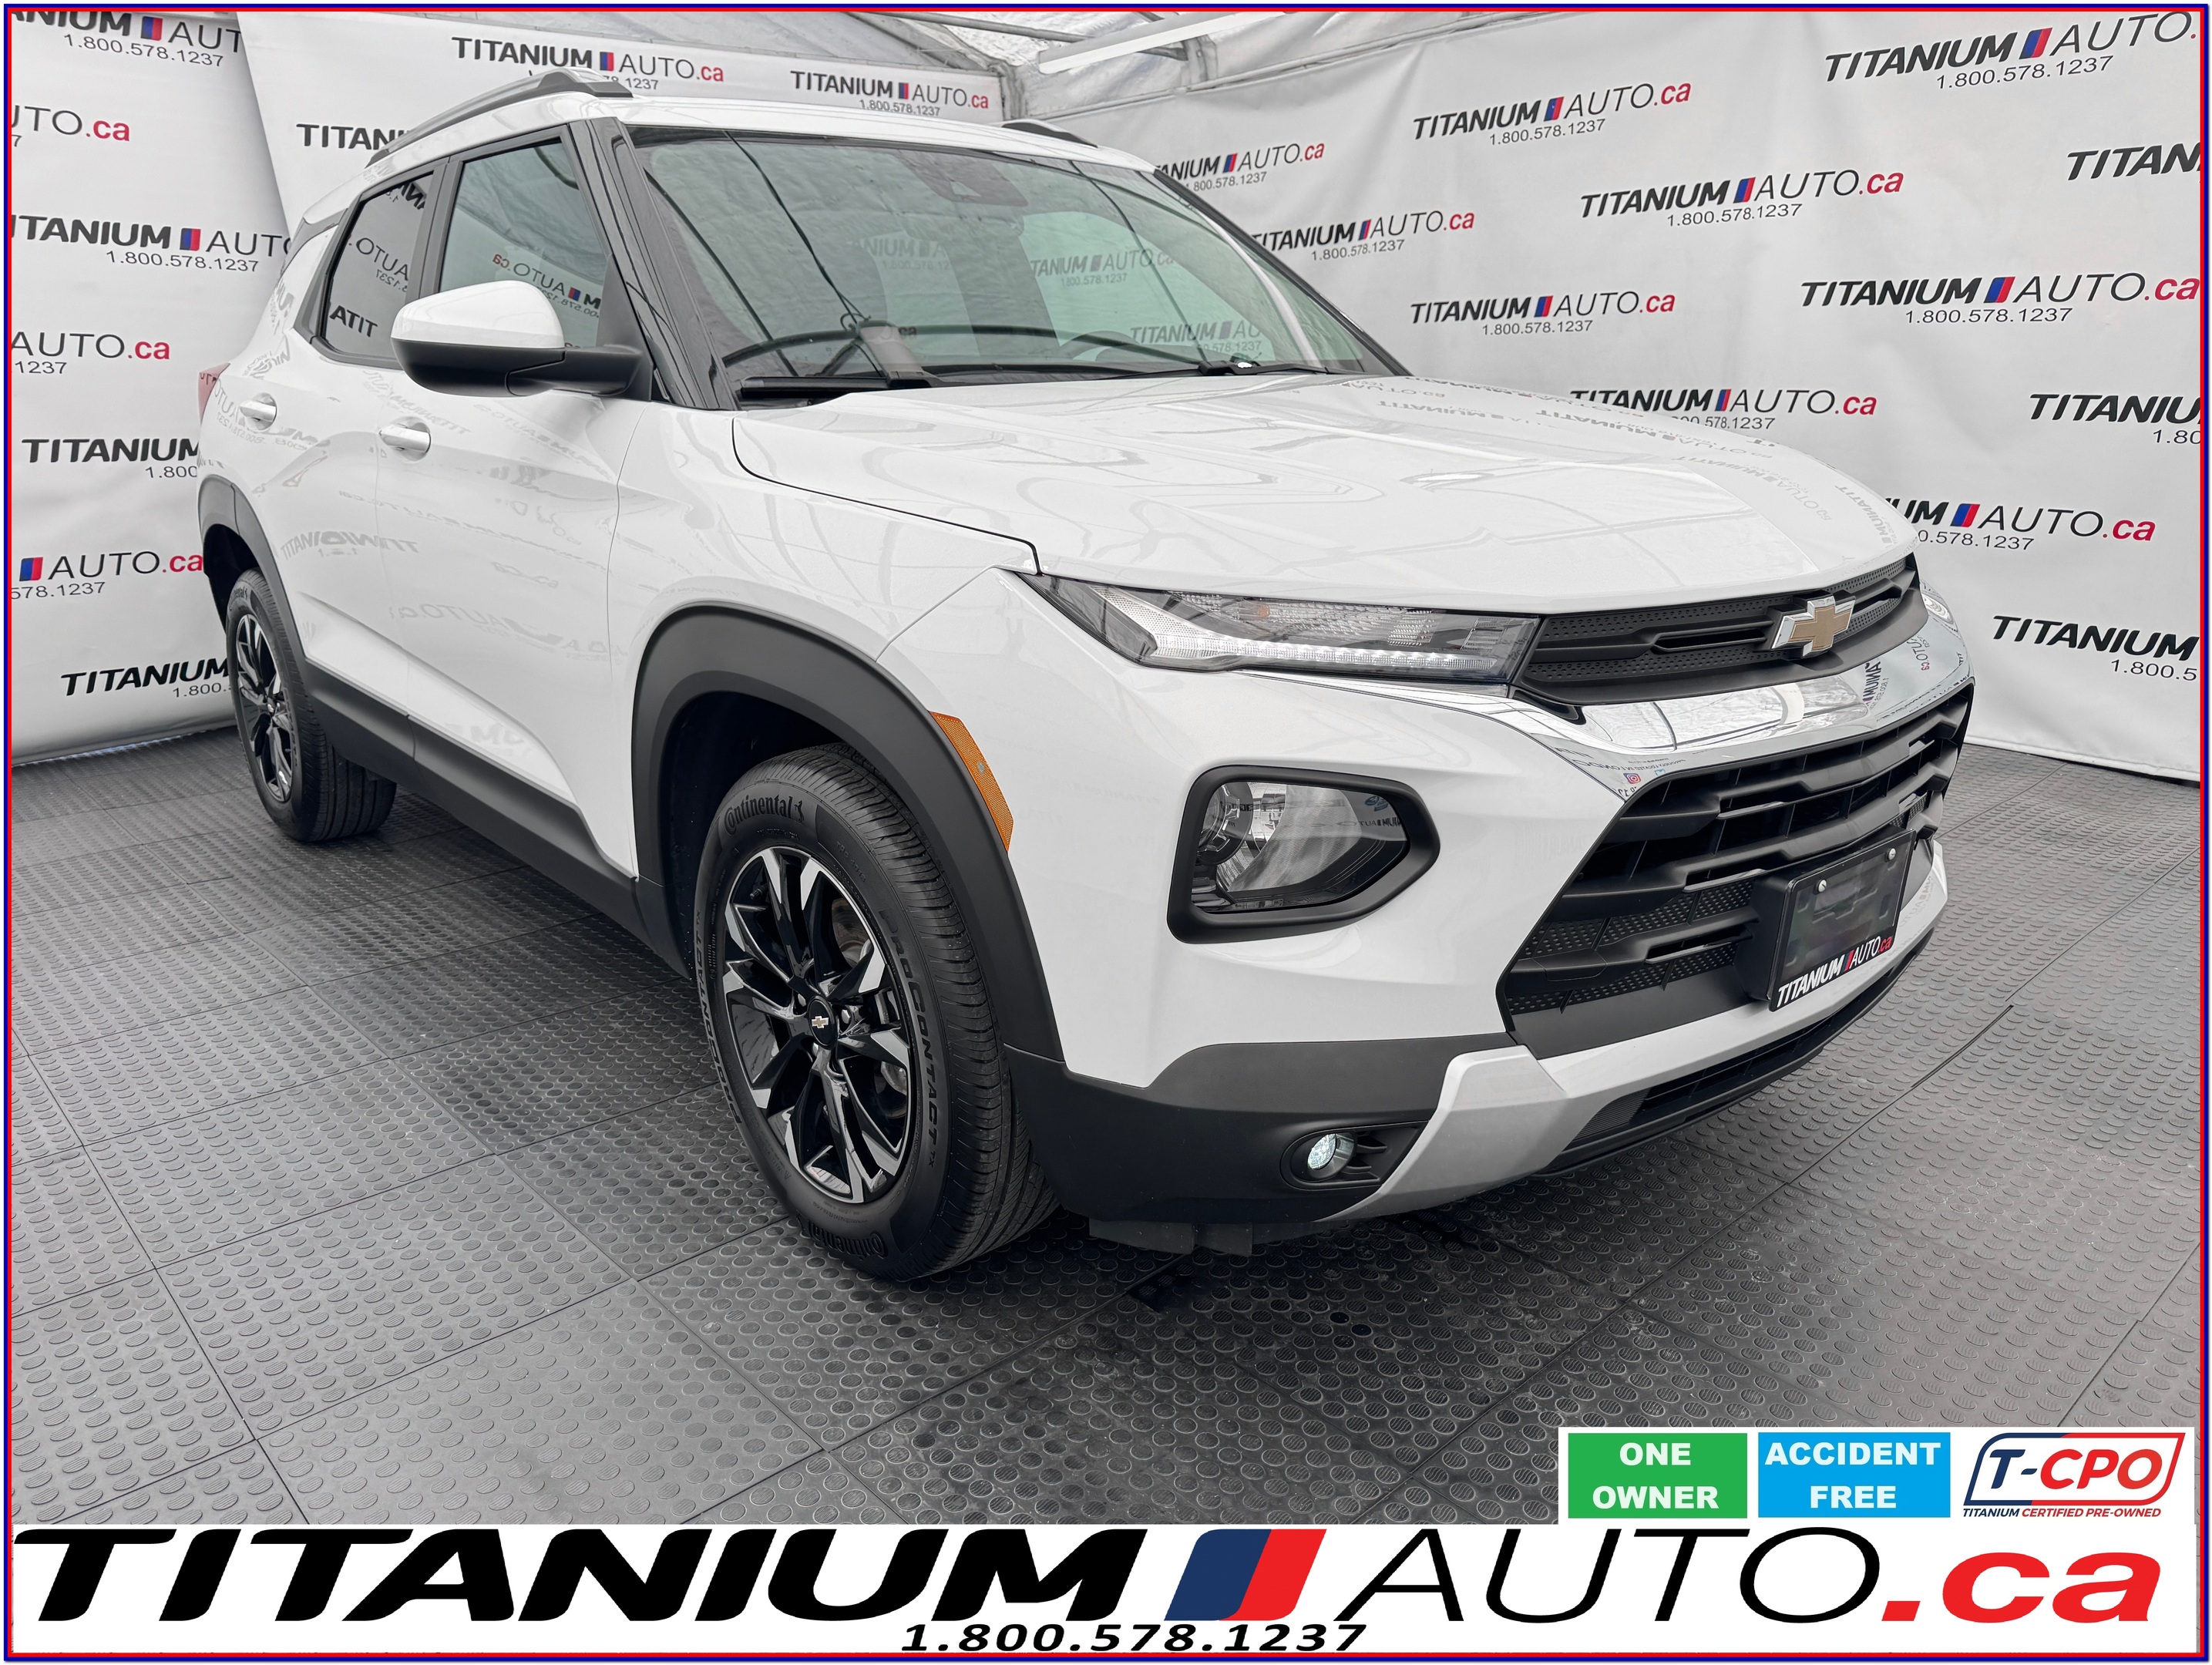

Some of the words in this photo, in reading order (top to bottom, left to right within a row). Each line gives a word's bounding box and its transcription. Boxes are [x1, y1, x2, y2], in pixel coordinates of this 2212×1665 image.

[64, 34, 224, 67] 1.800.578.1237
[451, 36, 592, 69] TITANIUM
[619, 53, 724, 82] AUTO.ca
[1825, 32, 2018, 82] TITANIUM
[1936, 55, 2113, 89] 1.800.578.1237
[790, 70, 893, 99] TITANIUM
[912, 83, 989, 109] AUTO.ca
[860, 99, 940, 116] 1.800.578.1237
[1414, 100, 1541, 140] TITANIUM
[1563, 82, 1691, 119] AUTO.ca
[1489, 119, 1605, 145] 1.800.578.1237
[1237, 143, 1325, 172] AUTO.ca
[2067, 142, 2201, 181] TITAN
[1581, 180, 1730, 218] TITANIUM
[1754, 169, 1904, 202] AUTO.ca
[1370, 210, 1475, 237] AUTO.ca
[1667, 204, 1803, 227] 1.800.578.1237
[206, 230, 291, 257] AUT
[1312, 239, 1404, 261] 1.800.578.1237
[106, 251, 259, 272] 1.800.578.1237
[1800, 278, 1982, 307] TITANIUM
[2012, 272, 2200, 302] AUTO.ca
[1410, 297, 1532, 324] TITANIUM
[1553, 291, 1676, 317] AUTO.ca
[1905, 308, 2073, 324] 1.800.578.1237
[1482, 320, 1593, 336] 1.800.578.1237
[12, 331, 170, 360] AUTO.ca
[1730, 389, 1877, 415] AUTO.ca
[2029, 394, 2201, 425] TITANIU
[1978, 506, 2156, 542] AUTO.ca
[48, 550, 203, 580] AUTO.ca
[1993, 615, 2200, 661] TITANIUM
[173, 682, 231, 698] 1.800.
[724, 794, 793, 836] Continental
[1776, 954, 1845, 1008] TITANIUM
[1849, 935, 1893, 970] AUTO.ca
